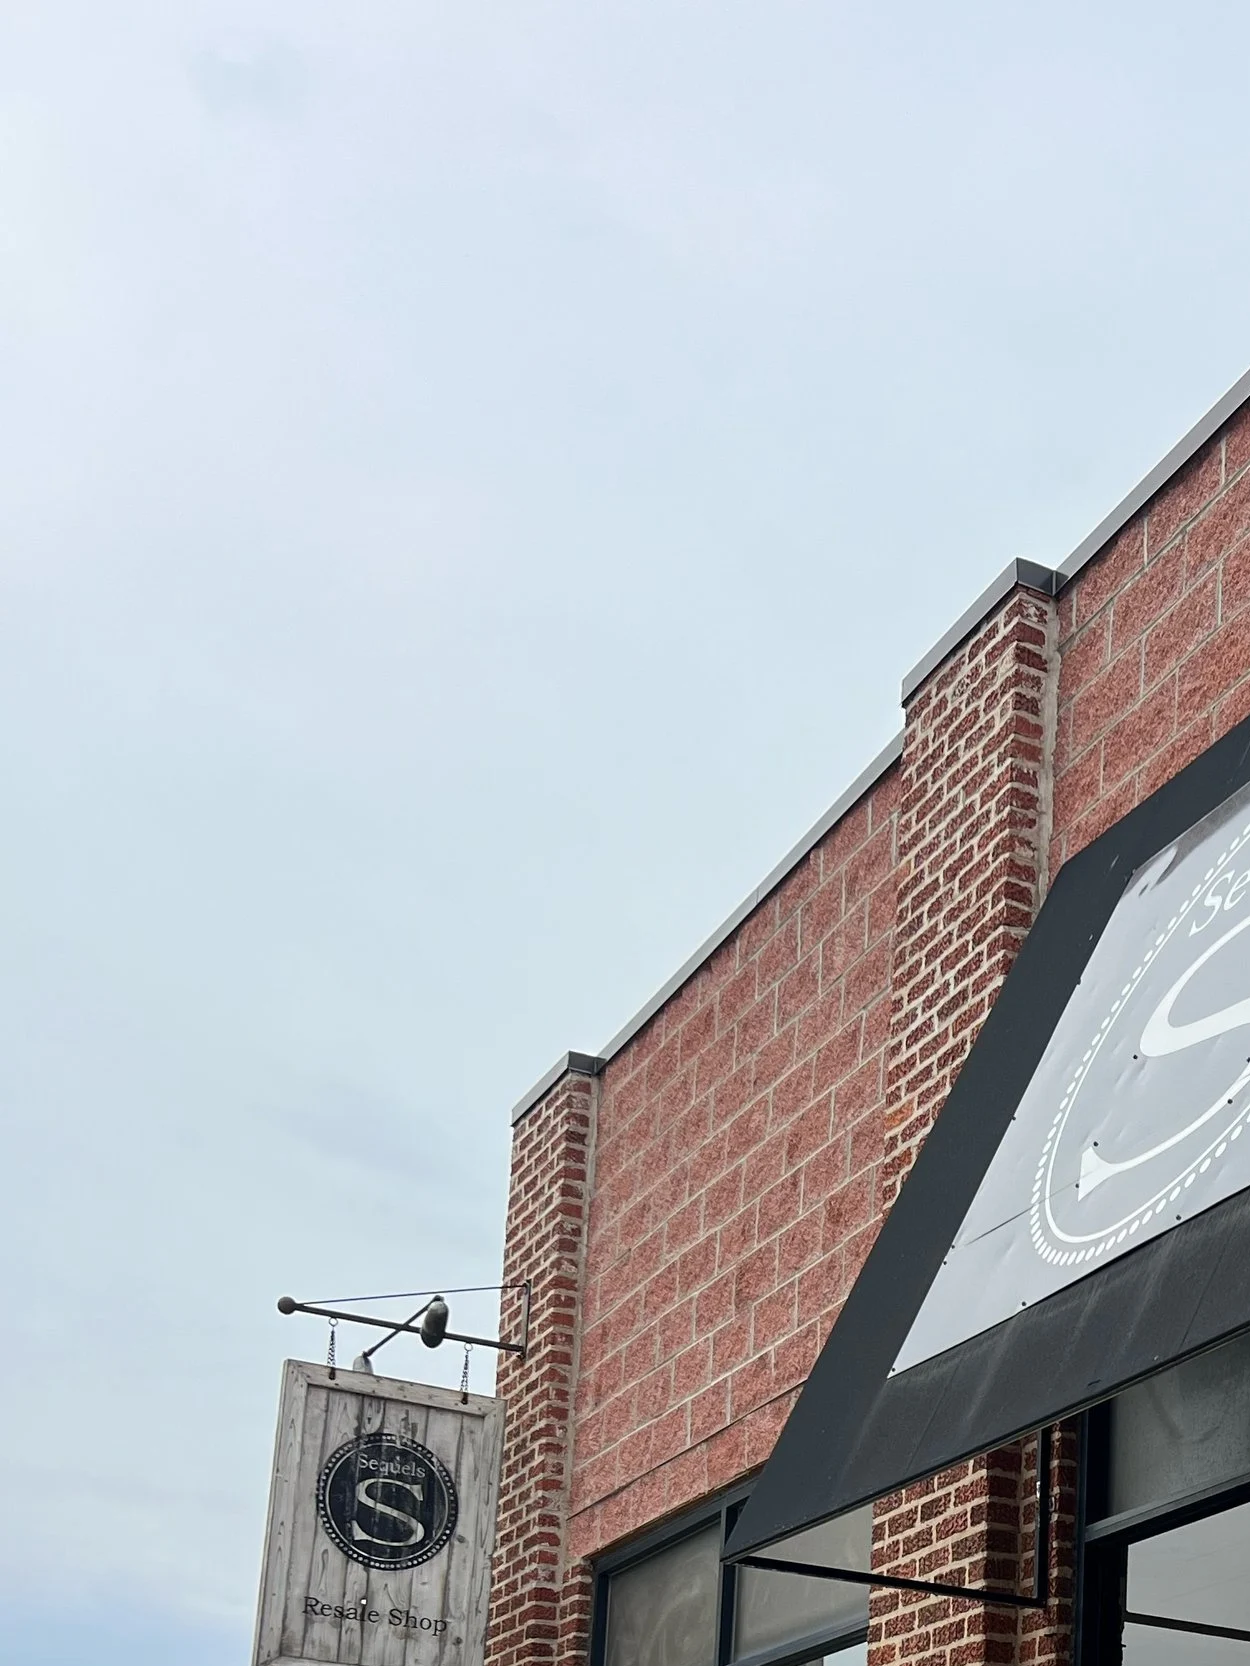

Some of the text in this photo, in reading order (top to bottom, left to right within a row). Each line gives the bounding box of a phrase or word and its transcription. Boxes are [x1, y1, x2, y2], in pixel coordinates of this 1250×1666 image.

[358, 1453, 426, 1478] Sequels
[352, 1478, 425, 1547] S
[302, 1596, 448, 1637] Resale Shop
